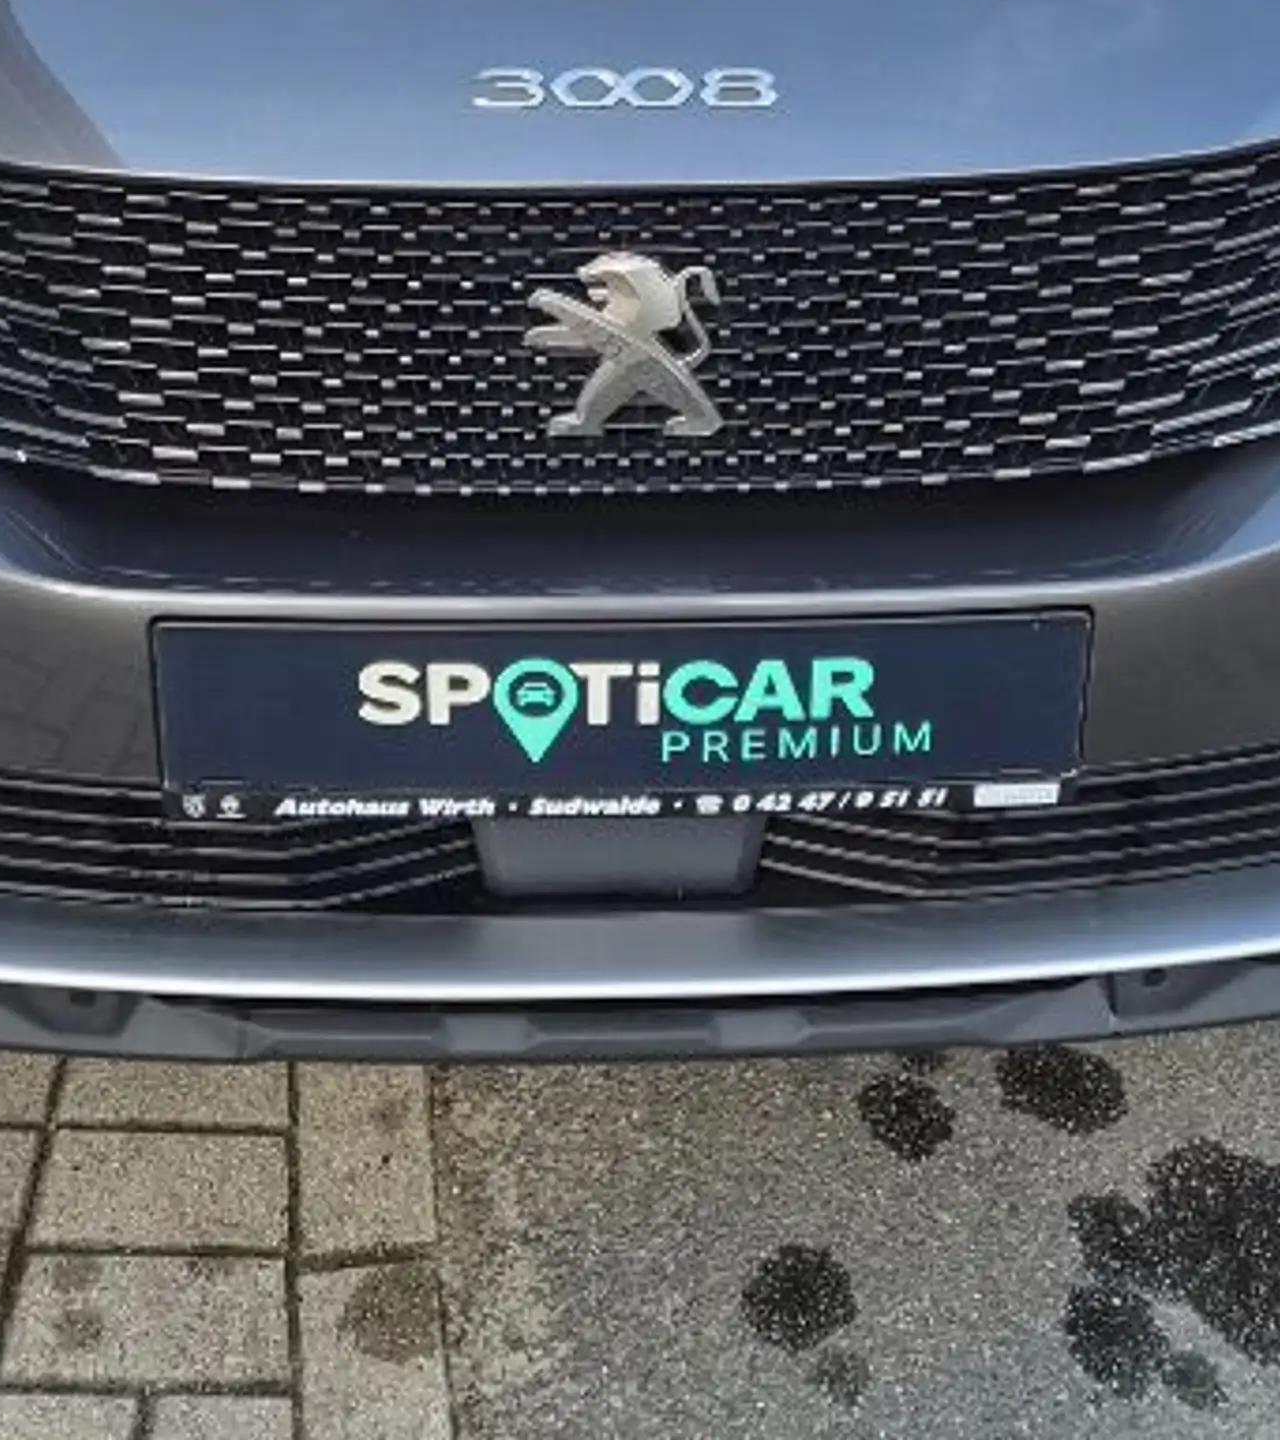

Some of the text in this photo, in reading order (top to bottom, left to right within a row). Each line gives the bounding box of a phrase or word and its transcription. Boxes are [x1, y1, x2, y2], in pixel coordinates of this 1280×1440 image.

[472, 67, 780, 108] 3008
[661, 721, 932, 762] PREMIUM
[274, 797, 412, 817] Autohaus
[419, 796, 496, 817] Wirth
[528, 795, 662, 817] Sudwalde
